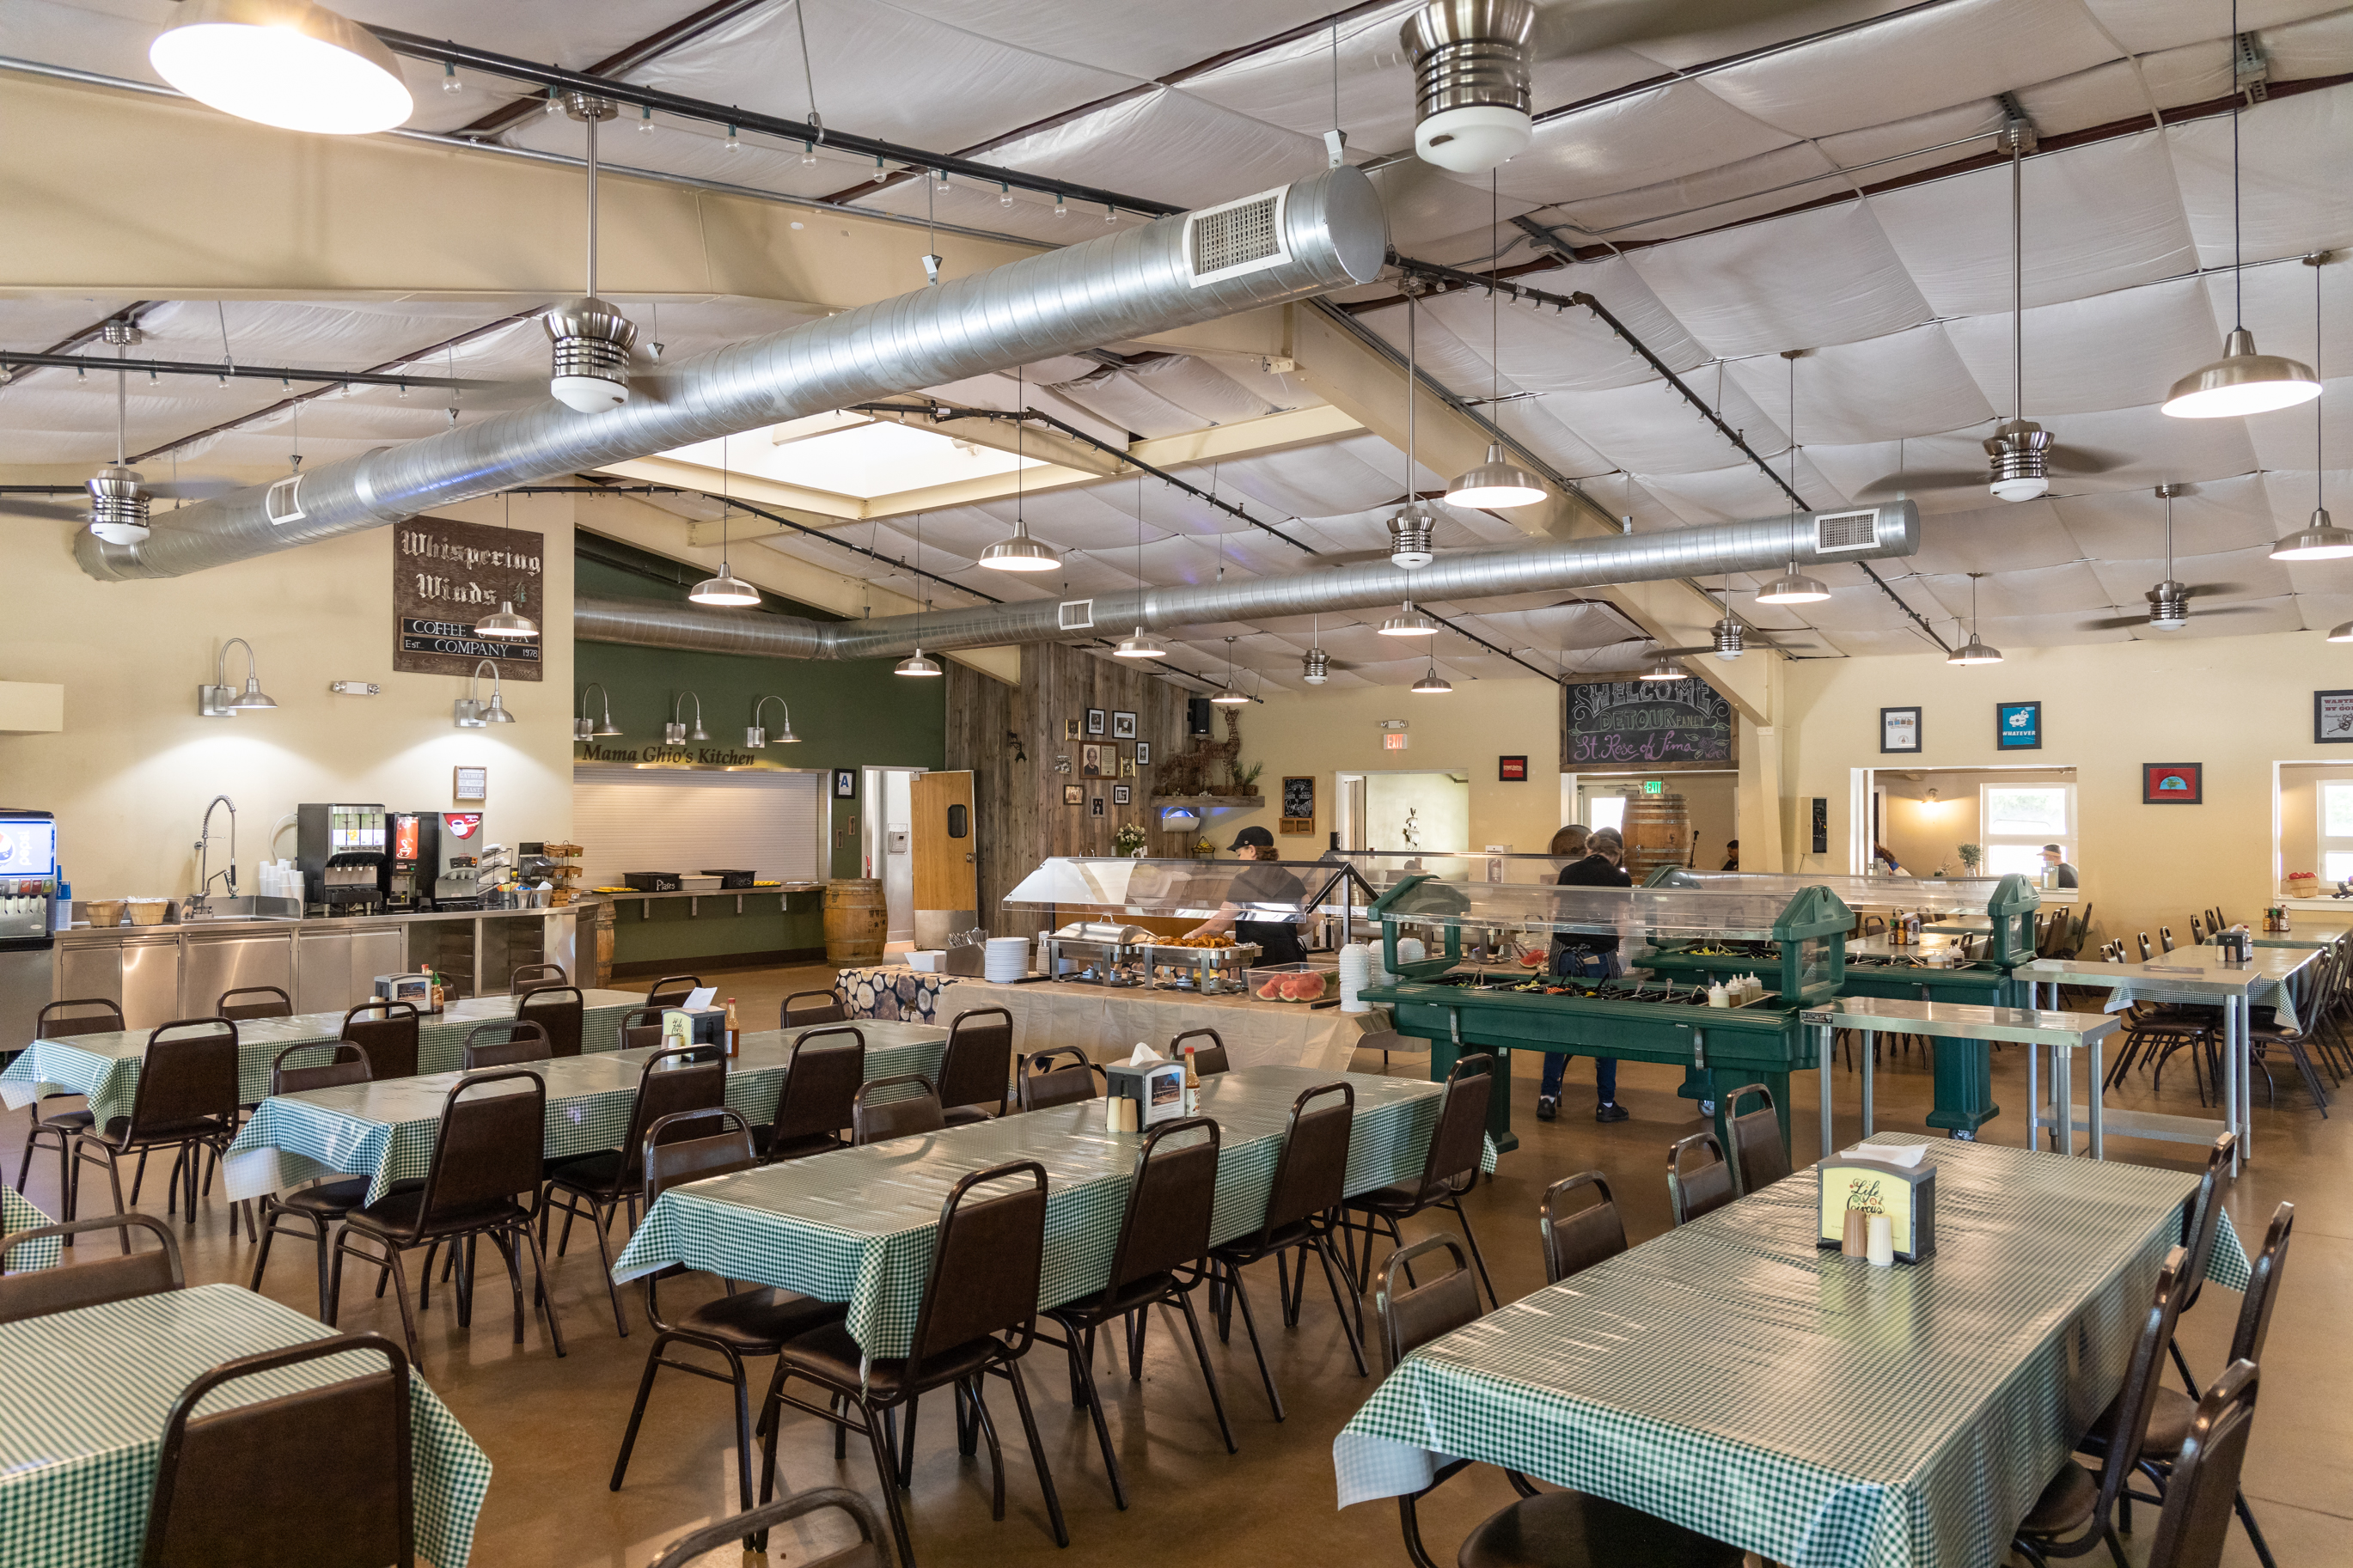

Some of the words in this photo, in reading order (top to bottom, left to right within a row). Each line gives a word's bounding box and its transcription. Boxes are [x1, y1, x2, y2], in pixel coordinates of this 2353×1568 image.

[400, 530, 541, 577] Whispering
[416, 572, 497, 606] Winds
[413, 619, 467, 638] COFFEE
[435, 638, 510, 657] COMPANY
[523, 649, 538, 658] 1978
[1590, 679, 1711, 713] WELCOME
[1599, 708, 1678, 731] DETOUR
[1387, 734, 1403, 749] EXIT
[1600, 734, 1640, 762] Rose
[1639, 732, 1657, 760] of
[583, 744, 638, 762] Mama
[642, 745, 694, 764] Ghio's
[698, 748, 755, 766] Kitchen
[840, 775, 849, 788] A
[1647, 781, 1662, 794] EXIT
[18, 831, 32, 865] pepsi
[1851, 1178, 1880, 1203] Life
